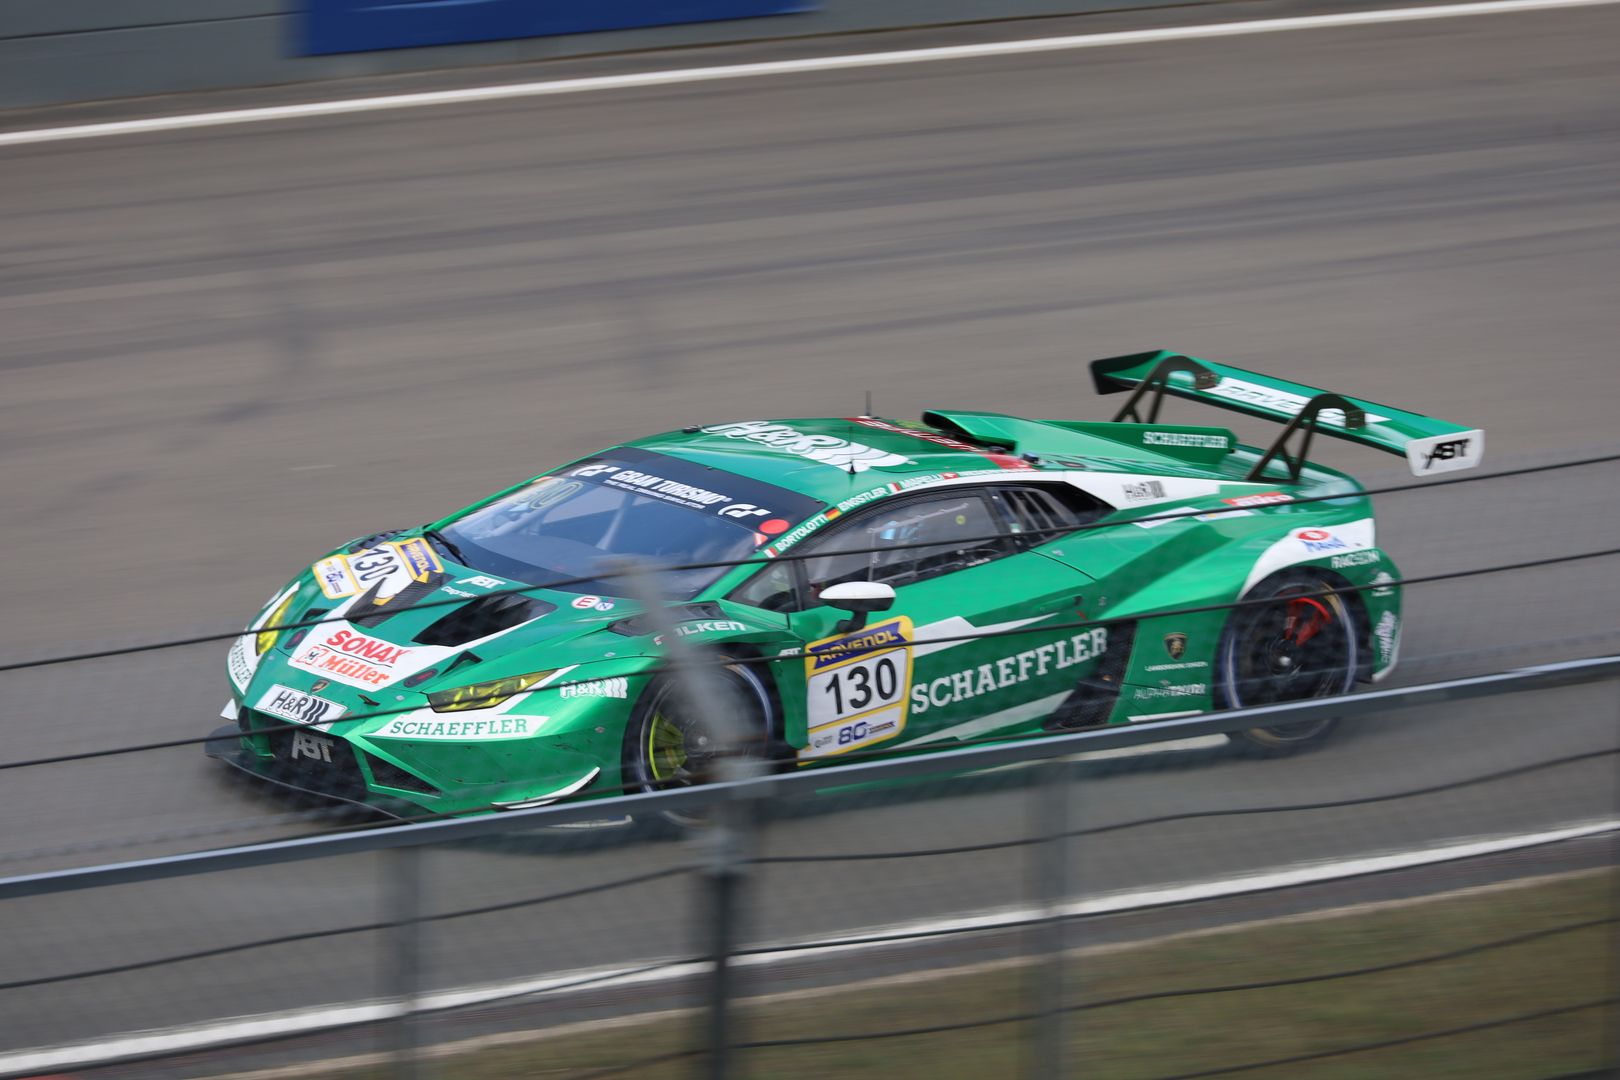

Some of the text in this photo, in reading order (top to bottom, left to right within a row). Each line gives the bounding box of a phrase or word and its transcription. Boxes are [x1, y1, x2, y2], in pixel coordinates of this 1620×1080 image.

[1424, 438, 1471, 469] ABT
[610, 470, 664, 487] GRAN
[837, 487, 888, 512] ENGSTLER
[775, 513, 830, 552] BORTOLOTTI
[354, 547, 400, 582] 130
[327, 629, 412, 665] SONAX
[319, 654, 392, 685] Müller
[911, 626, 1108, 715] SCHAEFFLER
[825, 657, 899, 715] 130
[390, 718, 528, 736] SCHAEFFLER
[838, 721, 868, 745] 80
[291, 730, 334, 763] ABT
